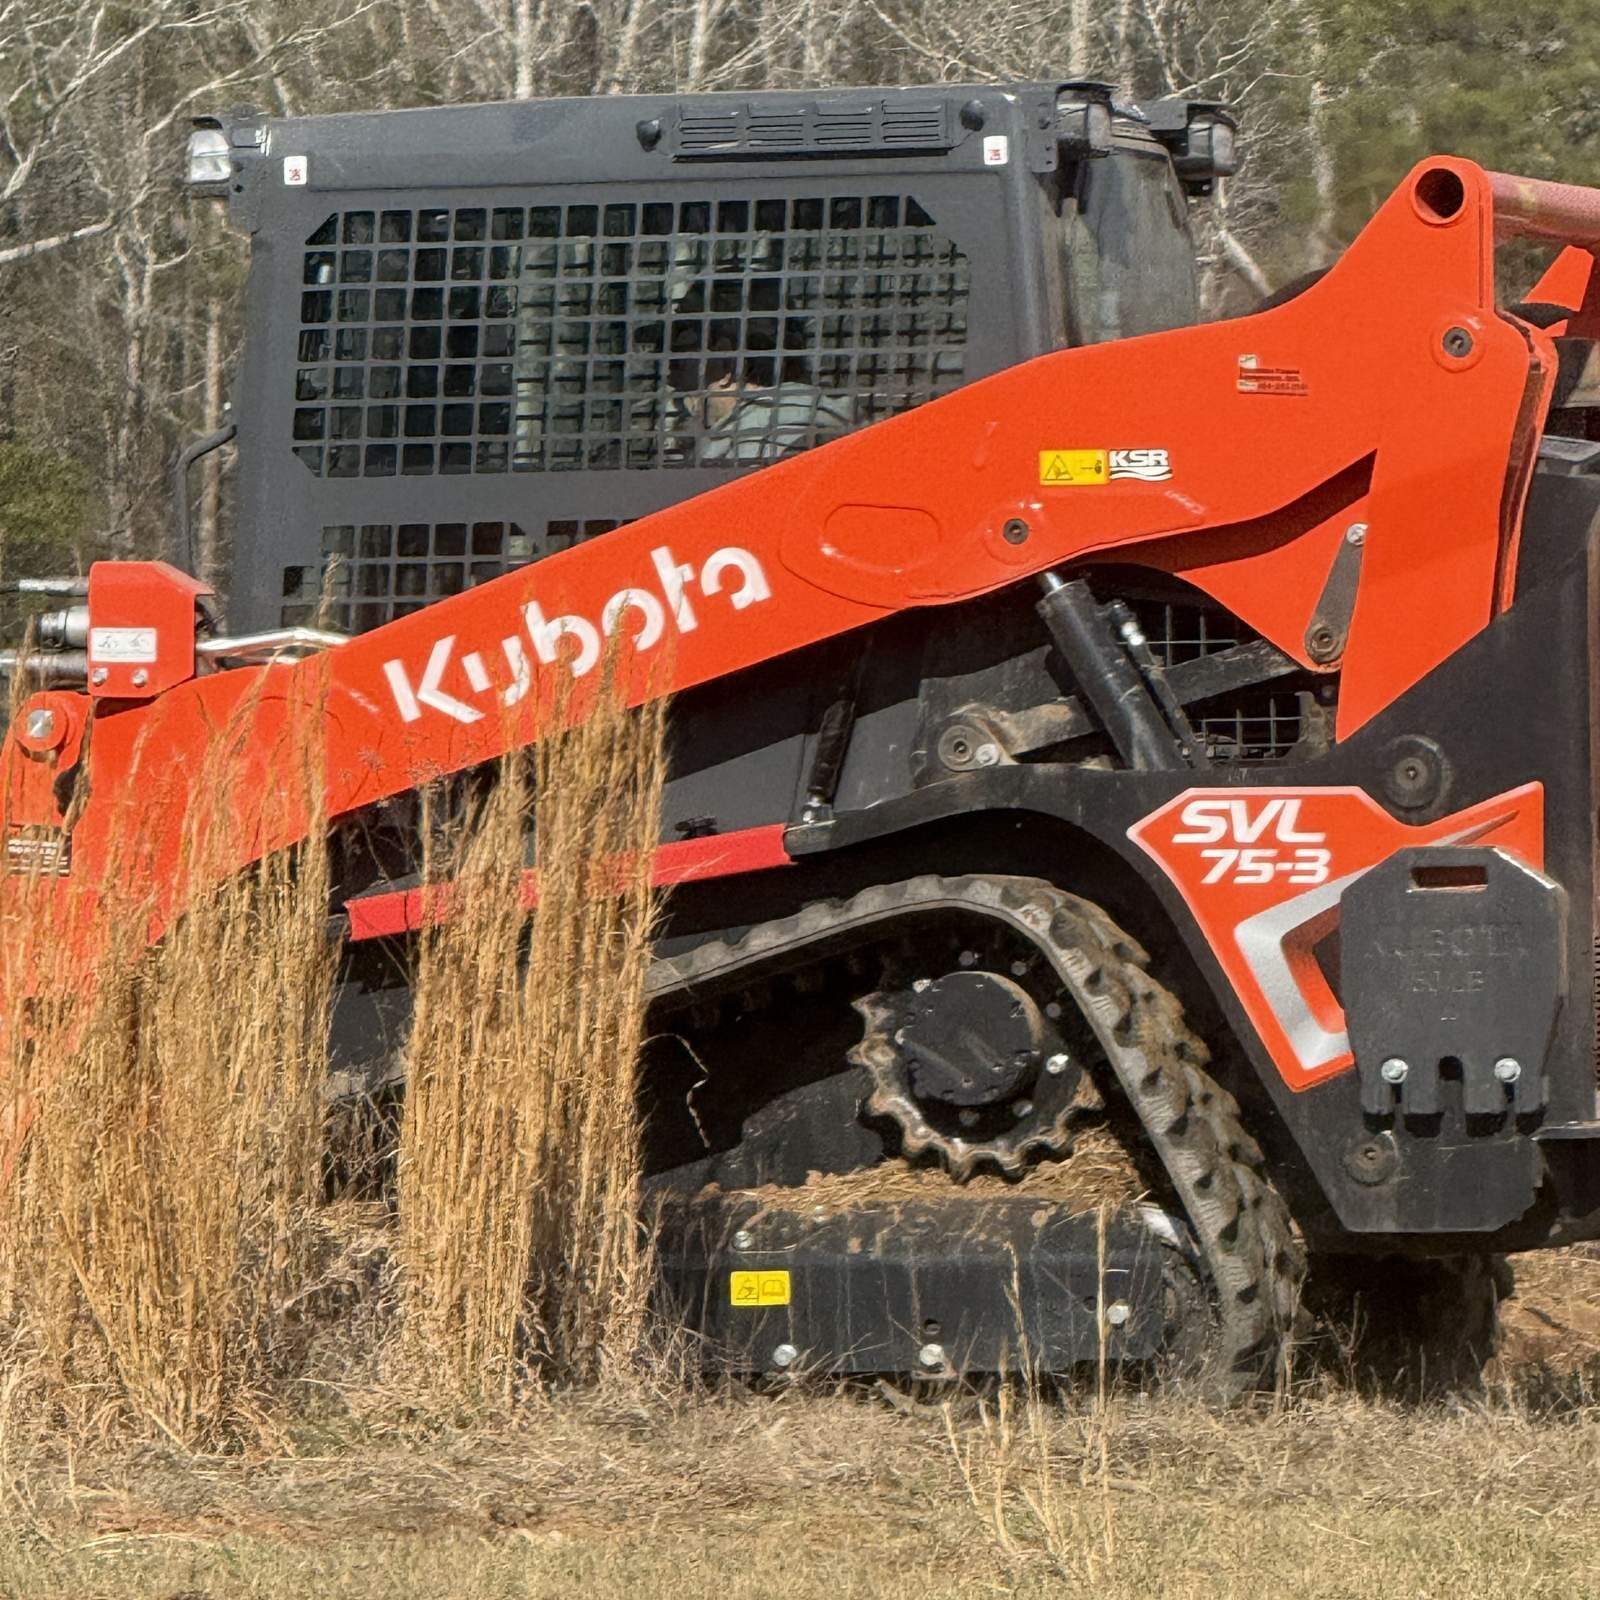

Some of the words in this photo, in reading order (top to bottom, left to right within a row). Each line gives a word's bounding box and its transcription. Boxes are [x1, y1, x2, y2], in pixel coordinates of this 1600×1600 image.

[1109, 449, 1169, 466] KSR
[383, 546, 772, 724] Kubota
[1172, 799, 1326, 843] SVL
[1200, 848, 1331, 884] 75-3
